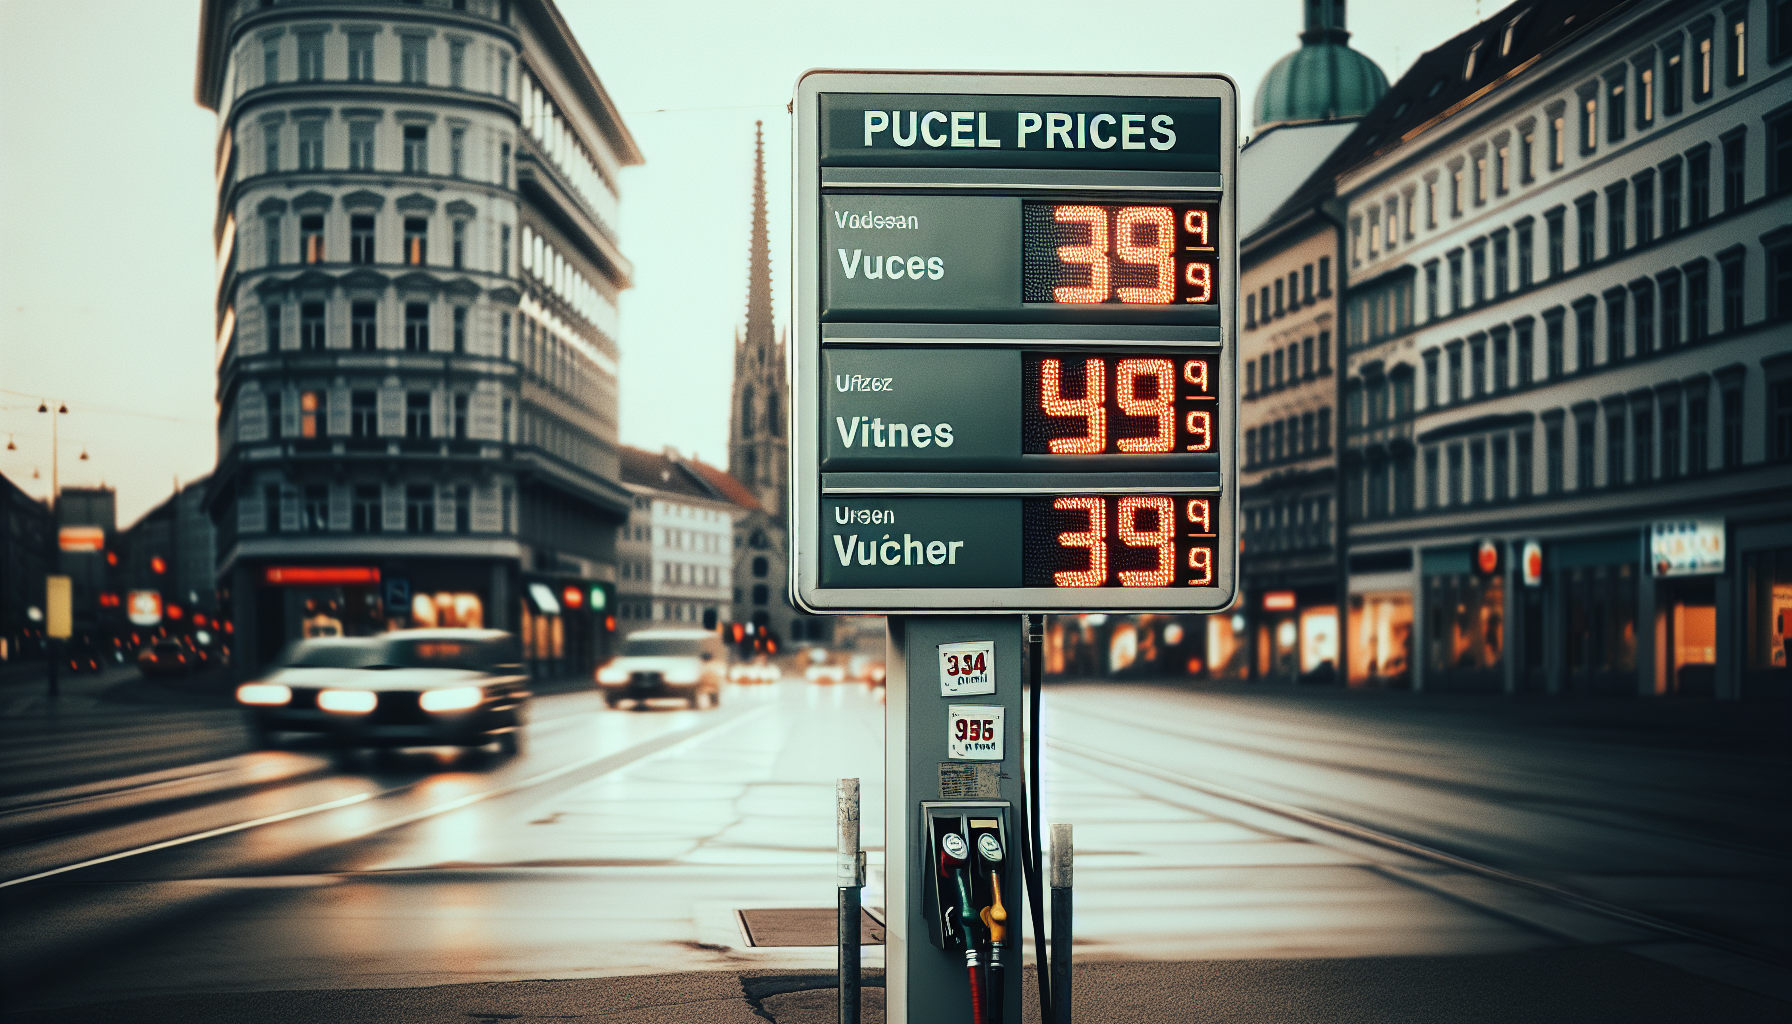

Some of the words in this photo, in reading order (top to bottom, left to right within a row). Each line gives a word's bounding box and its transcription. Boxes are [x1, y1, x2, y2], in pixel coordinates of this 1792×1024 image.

[863, 110, 1001, 148] PUCEL
[1017, 112, 1177, 151] PRICES
[837, 248, 945, 281] Vuces
[1053, 204, 1176, 304] 39
[835, 416, 954, 449] Vitnes
[1054, 496, 1176, 587] 39
